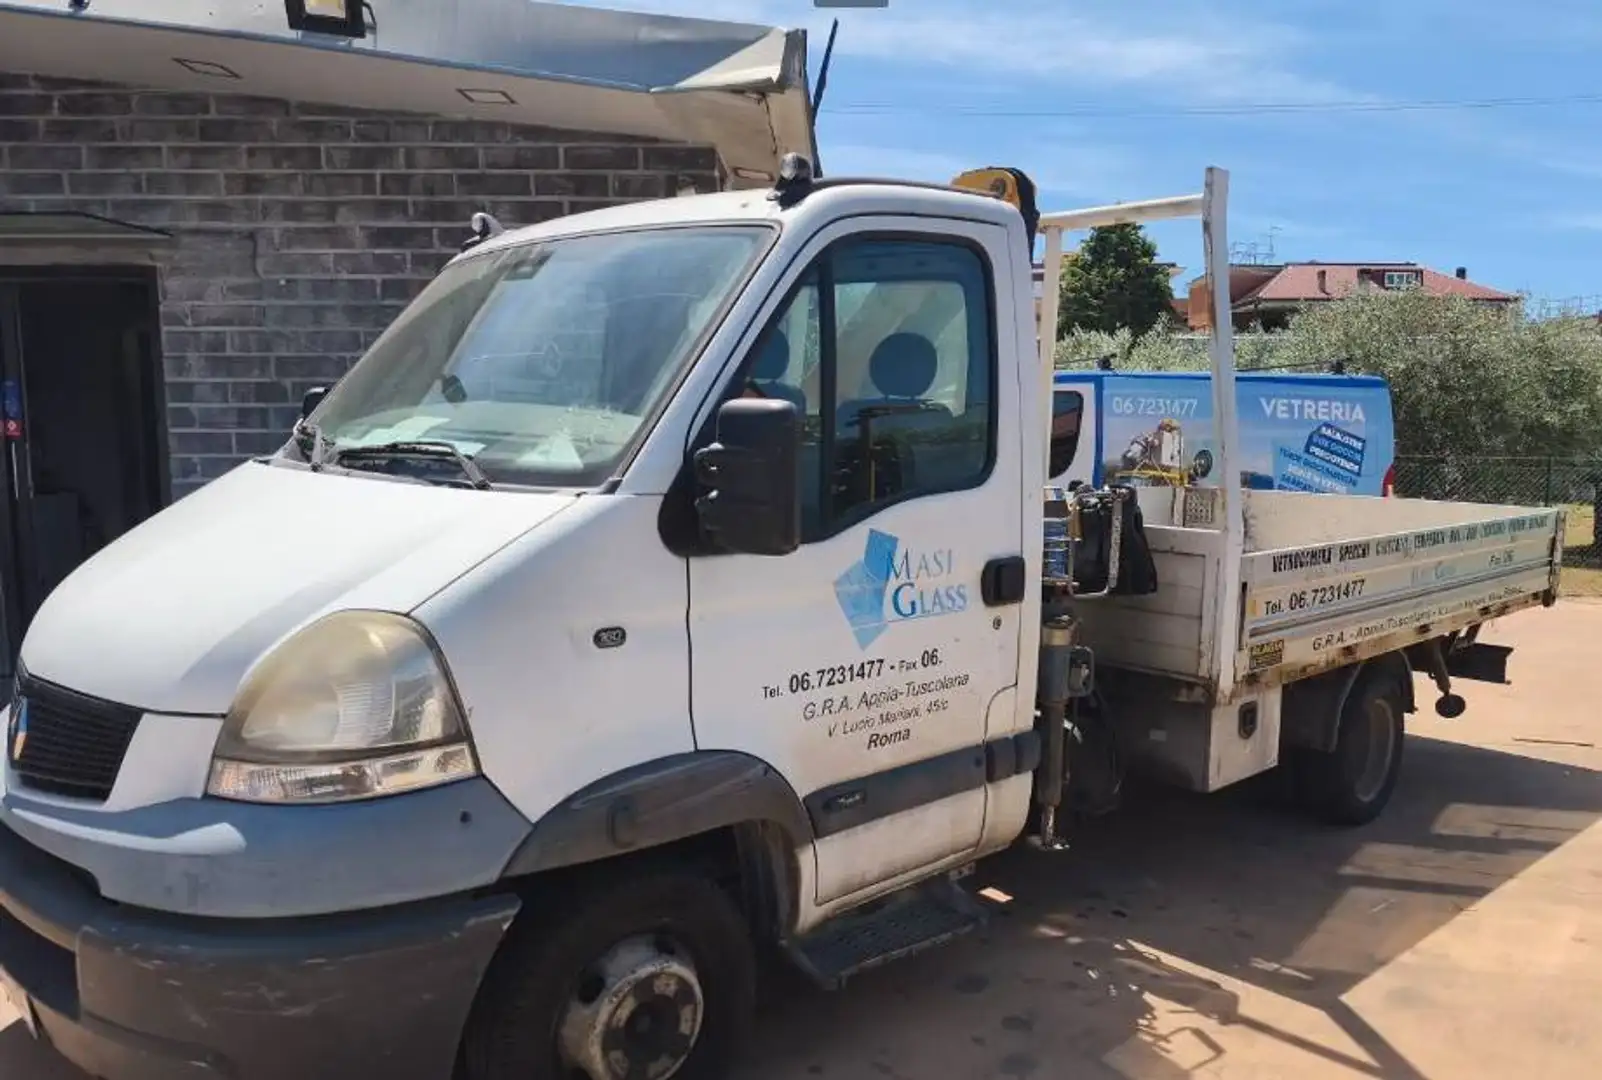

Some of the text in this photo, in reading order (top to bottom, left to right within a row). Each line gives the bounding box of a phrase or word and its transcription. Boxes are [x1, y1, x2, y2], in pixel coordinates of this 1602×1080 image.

[1260, 397, 1366, 421] VETRERIA
[886, 548, 953, 581] MASI
[892, 582, 968, 617] GLASS
[1264, 579, 1365, 615] Tel. 06.7231477
[762, 686, 783, 699] Tel.
[789, 659, 884, 694] 06.7231477
[898, 659, 917, 673] Fax
[921, 648, 943, 668] 06.
[803, 696, 853, 721] G.R.A.
[867, 728, 911, 750] Roma
